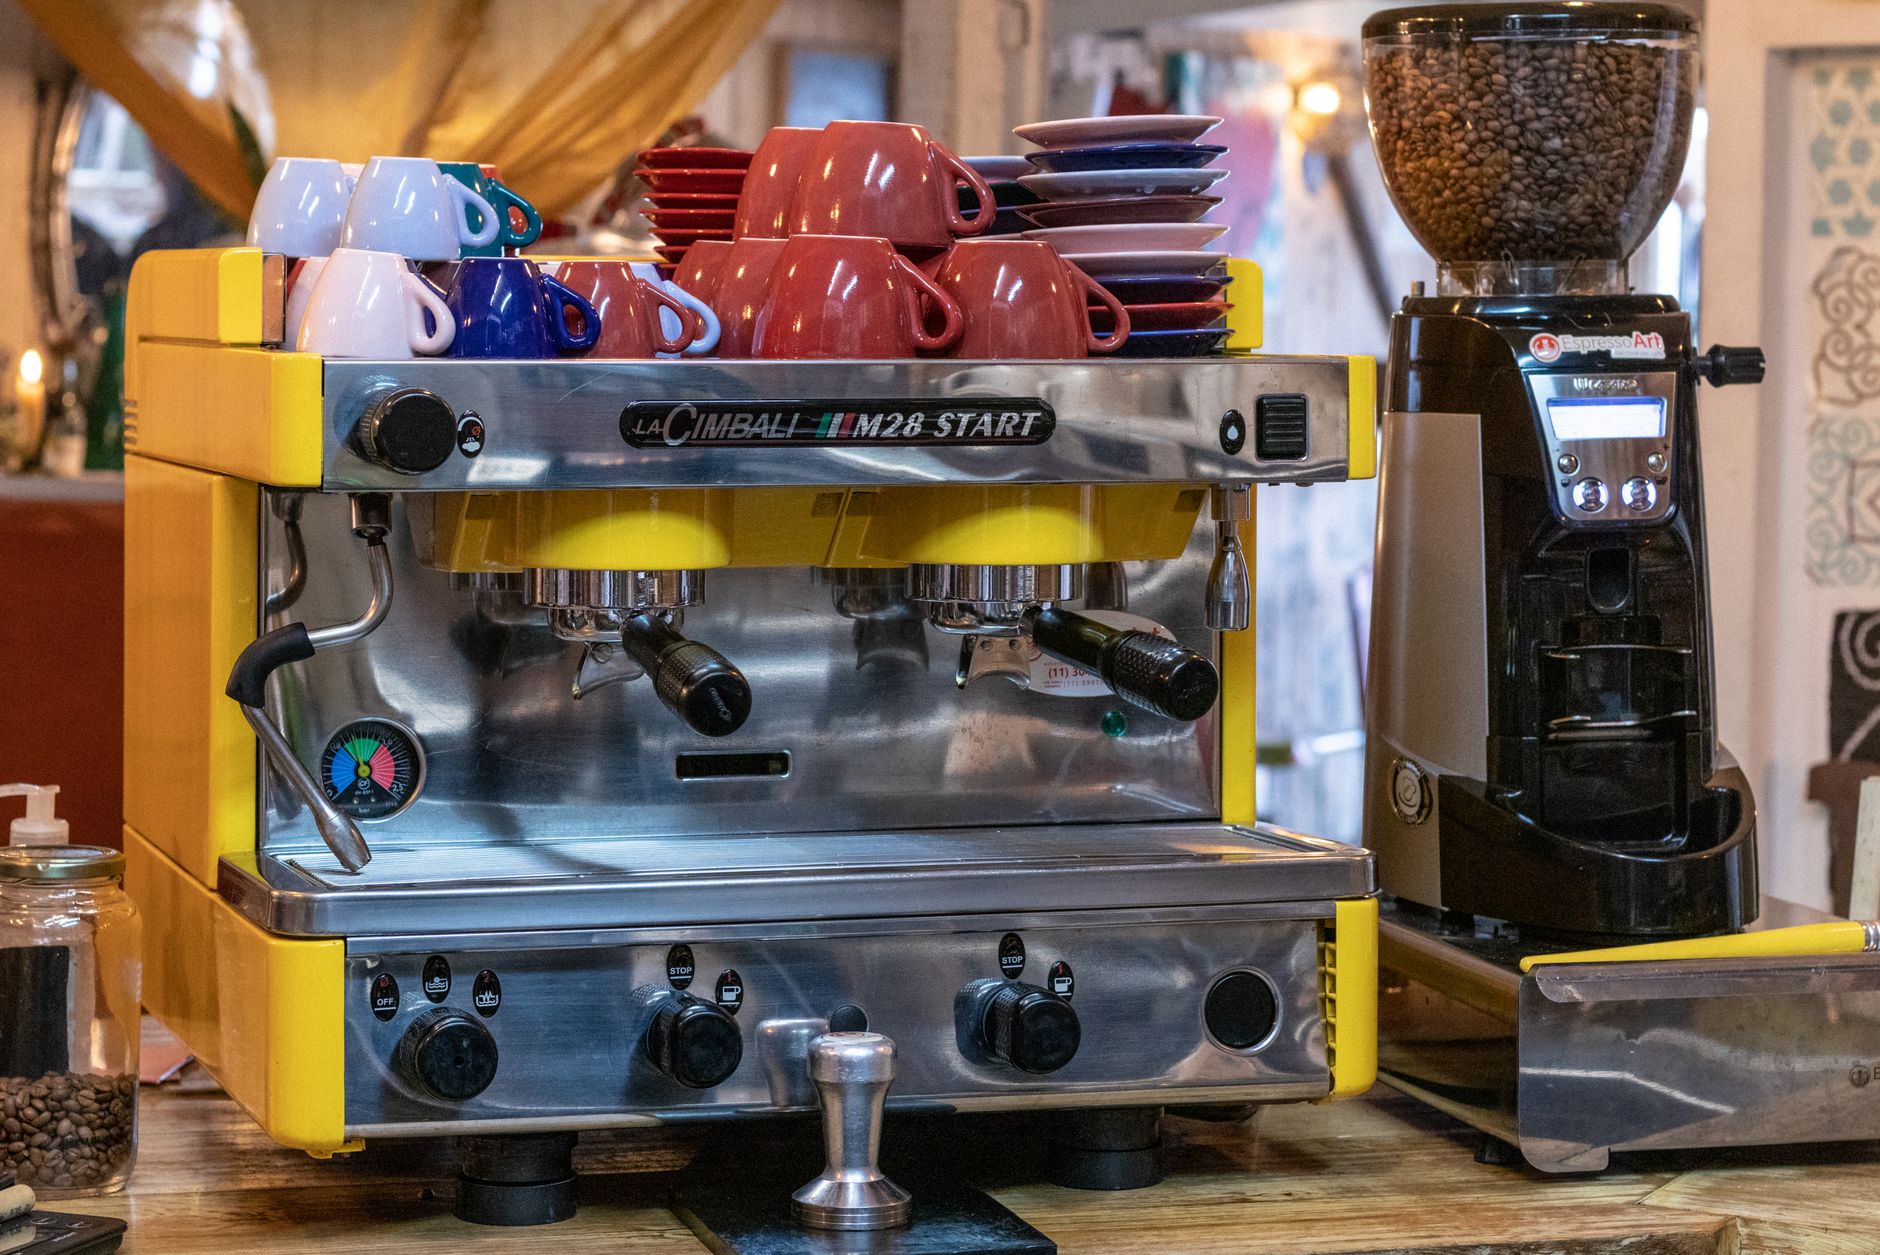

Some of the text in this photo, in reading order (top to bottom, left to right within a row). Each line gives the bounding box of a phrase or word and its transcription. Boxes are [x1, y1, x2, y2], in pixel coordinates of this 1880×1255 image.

[852, 412, 925, 438] M28
[933, 411, 1042, 438] START
[1048, 667, 1069, 679] (11)
[1001, 956, 1023, 965] STOP
[669, 966, 692, 975] STOP
[376, 997, 394, 1006] OFF
